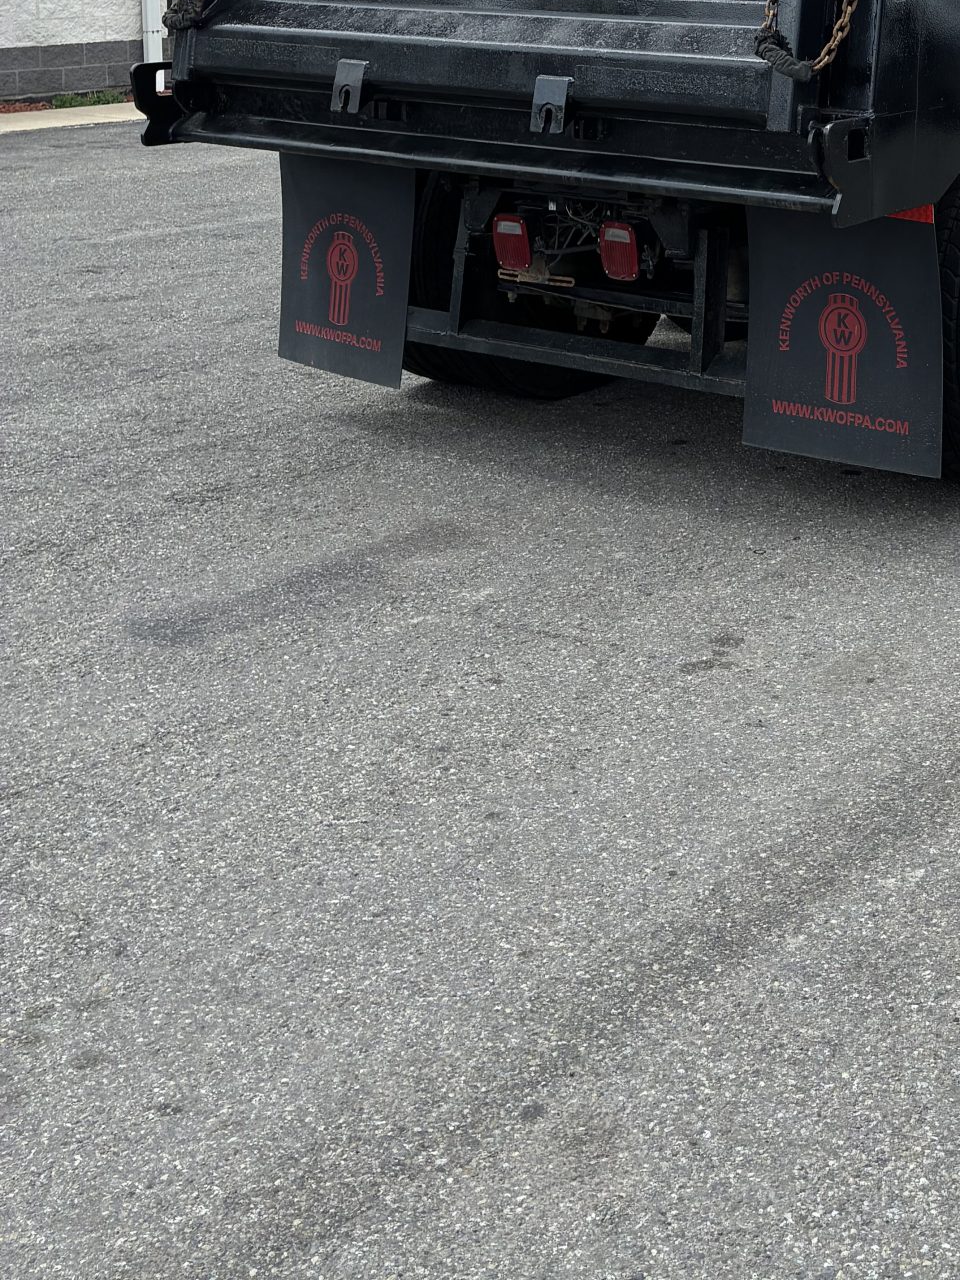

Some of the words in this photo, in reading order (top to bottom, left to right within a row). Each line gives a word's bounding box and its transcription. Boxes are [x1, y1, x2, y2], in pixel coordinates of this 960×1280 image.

[300, 219, 329, 280] KENWORTH
[330, 213, 342, 225] OF
[344, 214, 385, 297] PENNSYLVANIA
[295, 319, 381, 352] WWW.KWOFPA.COM
[779, 276, 821, 351] KENWORTH
[822, 272, 840, 285] OF
[843, 272, 908, 369] PENNSYLVANIA
[772, 399, 909, 435] WWW.KWOFPA.COM
